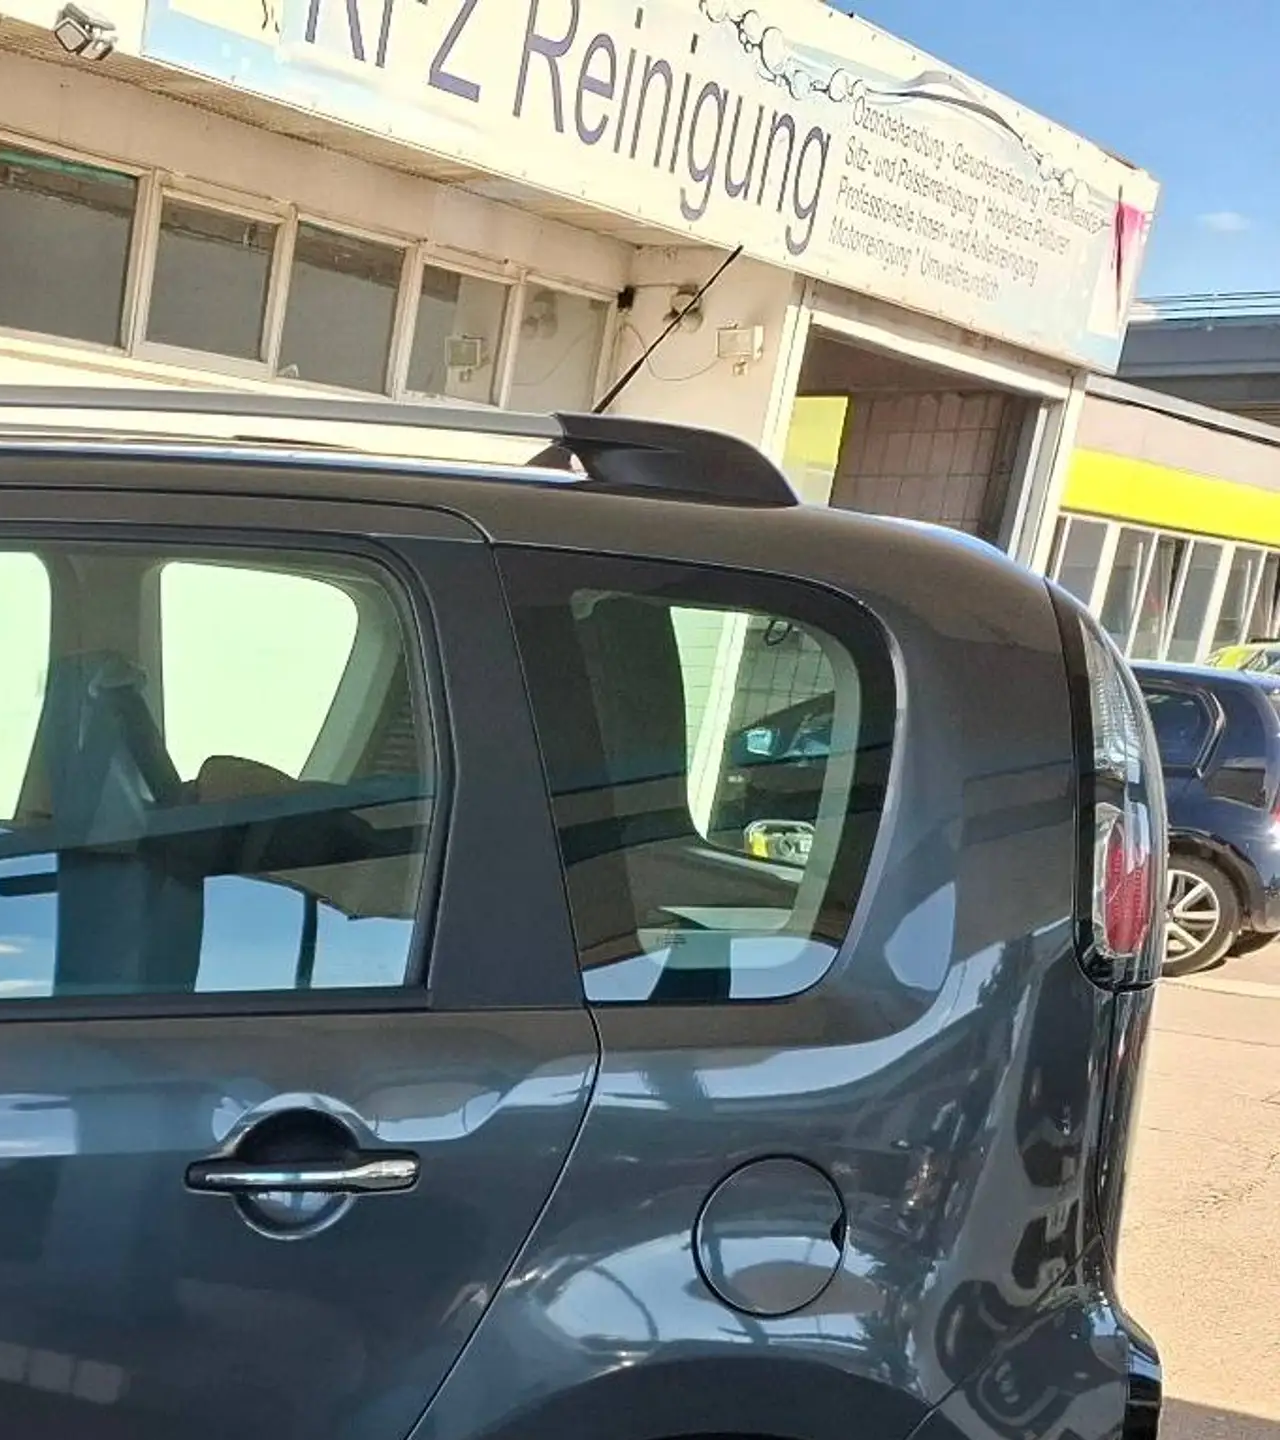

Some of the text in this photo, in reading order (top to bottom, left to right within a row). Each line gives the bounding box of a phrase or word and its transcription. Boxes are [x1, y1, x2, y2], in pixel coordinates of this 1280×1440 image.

[512, 0, 831, 256] Reinigung
[836, 174, 914, 231] Professionelle
[845, 135, 871, 172] Sitz-
[874, 156, 897, 183] und
[897, 157, 978, 223] Polsterreinigung
[828, 215, 912, 278] Motorreinigung
